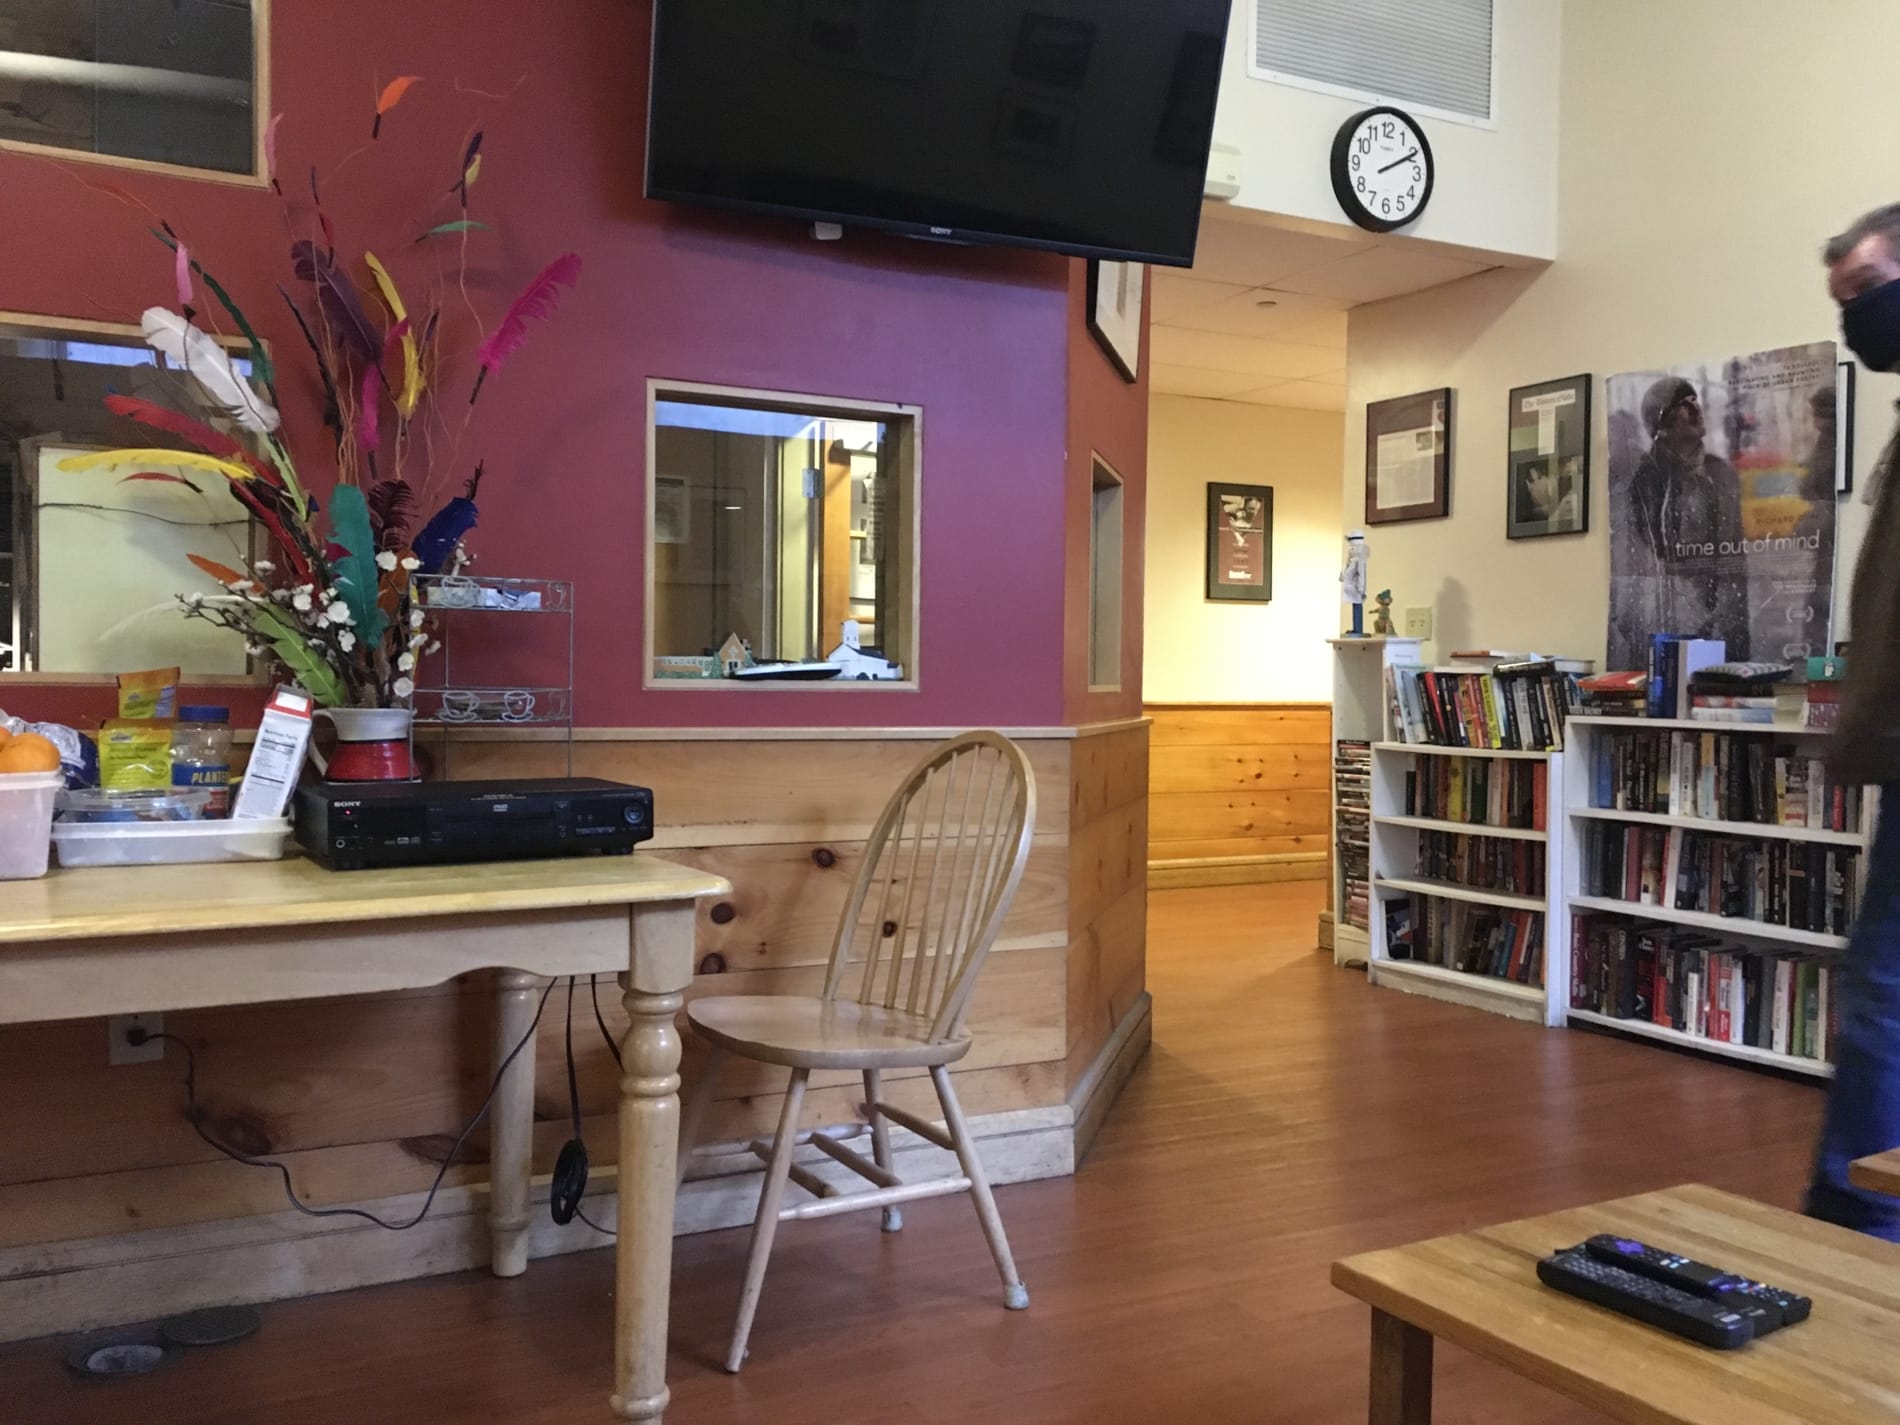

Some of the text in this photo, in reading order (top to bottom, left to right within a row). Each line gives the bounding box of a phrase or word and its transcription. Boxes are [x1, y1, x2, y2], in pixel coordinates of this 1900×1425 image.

[1367, 125, 1378, 141] 11
[1382, 122, 1395, 139] 12
[1400, 131, 1405, 146] 1
[1358, 137, 1371, 154] 10
[1352, 154, 1361, 171] 9
[1412, 165, 1422, 182] 3
[1357, 176, 1366, 192] 8
[1368, 190, 1377, 206] 7
[1407, 185, 1415, 200] 4
[1381, 197, 1391, 214] 6
[1396, 195, 1405, 211] 5
[930, 226, 952, 235] SONY
[1675, 528, 1820, 557] time out of mind
